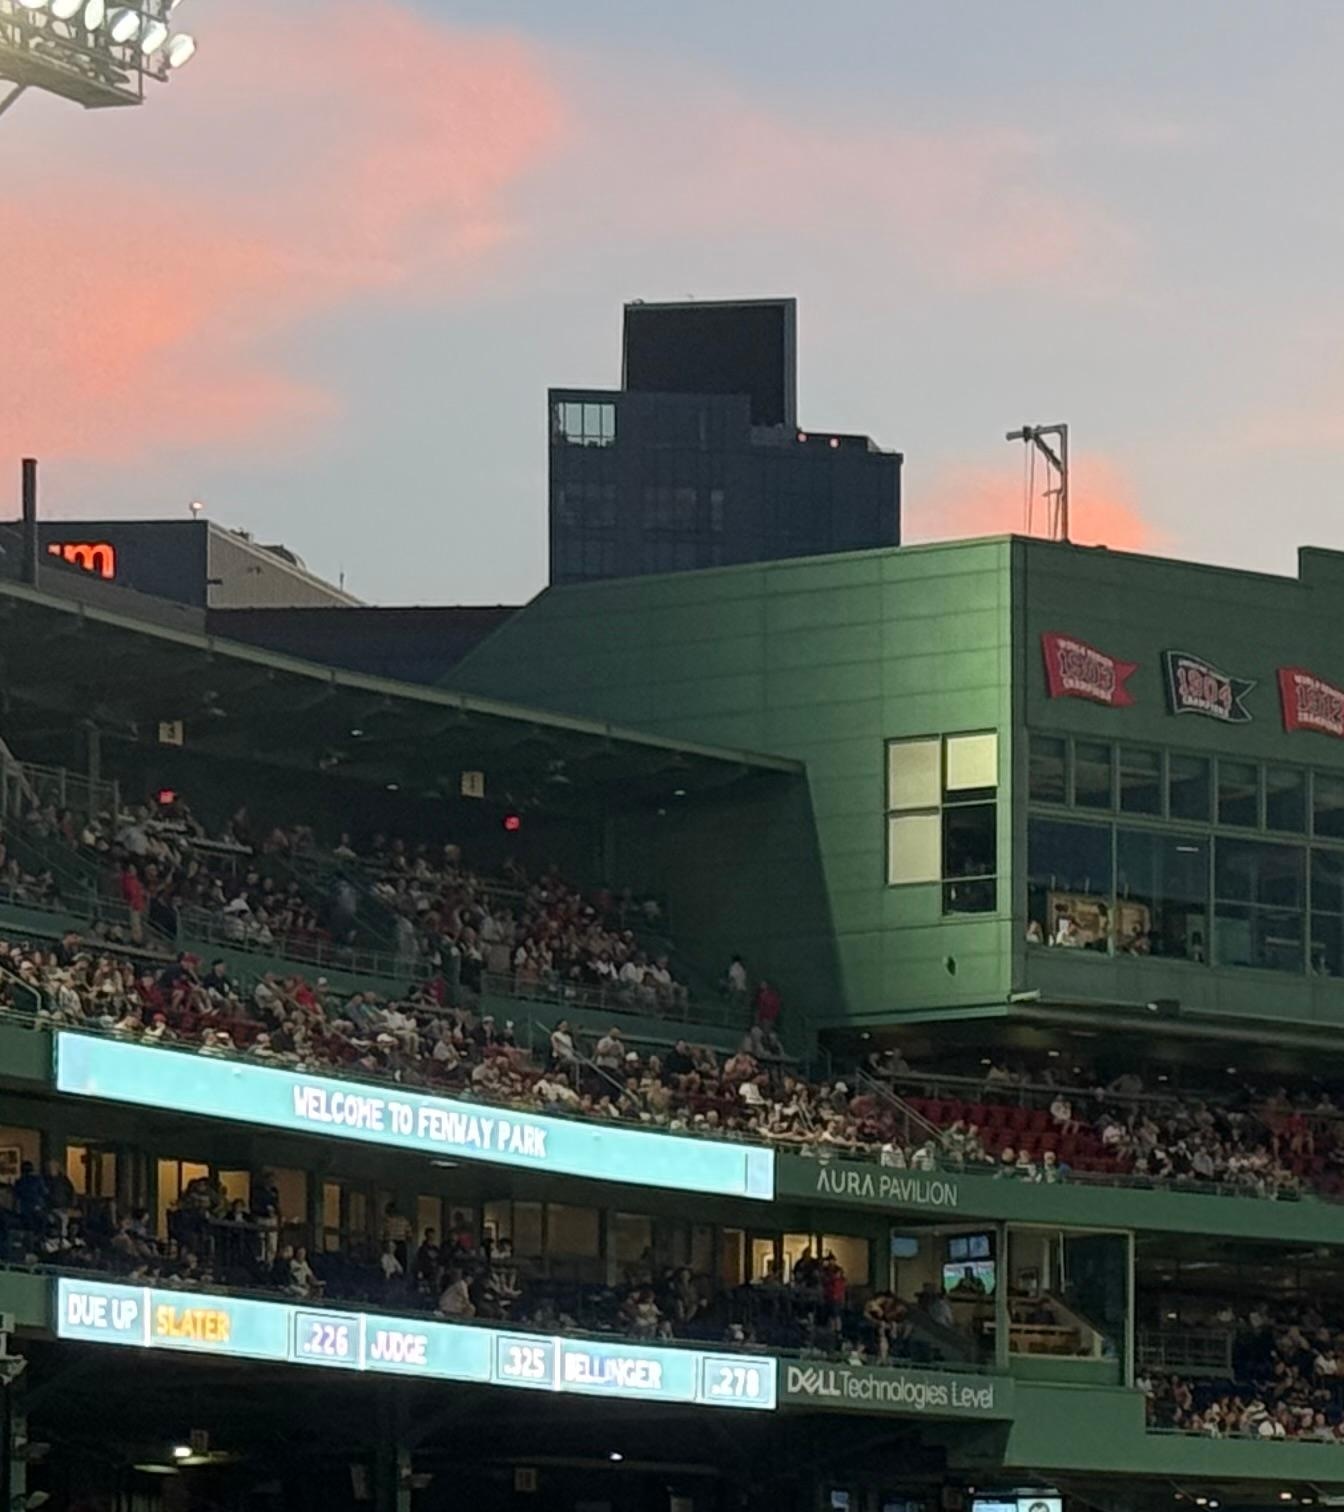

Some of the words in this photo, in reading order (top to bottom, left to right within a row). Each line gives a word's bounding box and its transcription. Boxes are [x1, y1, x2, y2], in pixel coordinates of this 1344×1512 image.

[1177, 667, 1232, 709] 1904
[293, 1085, 384, 1131] WELCOME
[389, 1102, 413, 1135] TO
[417, 1107, 494, 1149] FENWAY
[498, 1121, 547, 1158] PARK
[880, 1176, 957, 1206] PAVILION
[68, 1294, 108, 1327] DUE
[111, 1299, 138, 1329] UP
[157, 1306, 230, 1342] SLATER
[304, 1323, 348, 1356] .226
[371, 1331, 427, 1366] JUDGE
[503, 1346, 545, 1378] .325
[565, 1352, 662, 1389] BELLINGER
[788, 1366, 841, 1396] DELL
[840, 1371, 948, 1409] Technologies
[952, 1381, 993, 1409] Level
